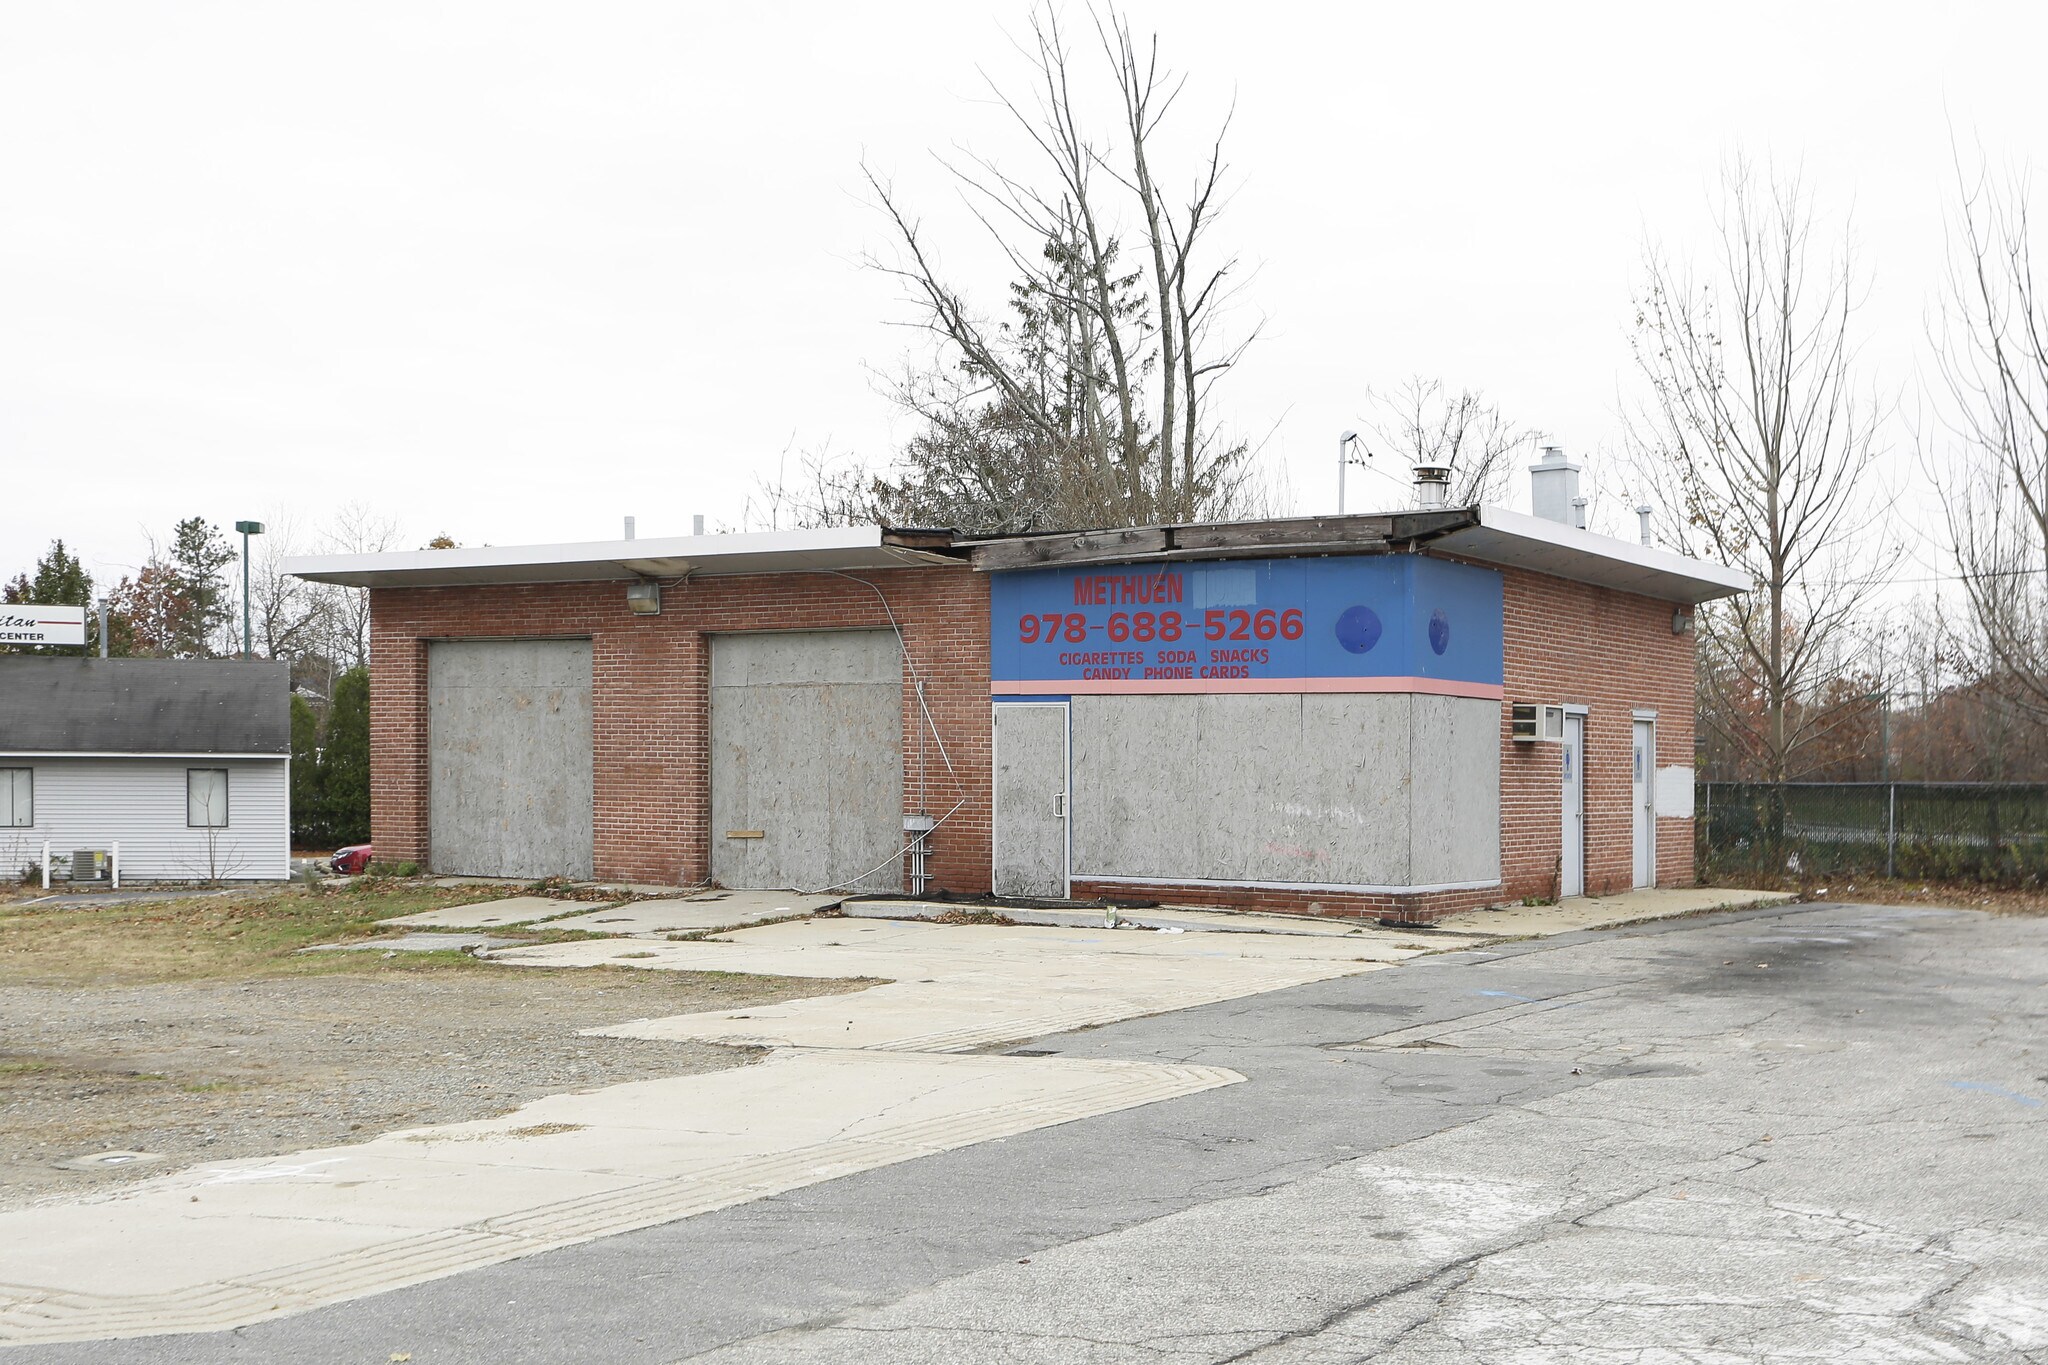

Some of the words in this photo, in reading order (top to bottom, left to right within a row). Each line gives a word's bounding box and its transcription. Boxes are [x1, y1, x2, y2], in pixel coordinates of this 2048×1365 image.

[1074, 573, 1183, 605] METHUEN
[1020, 609, 1303, 643] 978-688-5266
[0, 632, 44, 640] CENTER
[1059, 651, 1144, 665] CIGARETTES
[1157, 650, 1197, 664] SODA
[1210, 648, 1270, 665] SNACKS
[1083, 667, 1131, 680] CANDY
[1144, 666, 1193, 679] PHONE
[1200, 665, 1250, 679] CARDS
